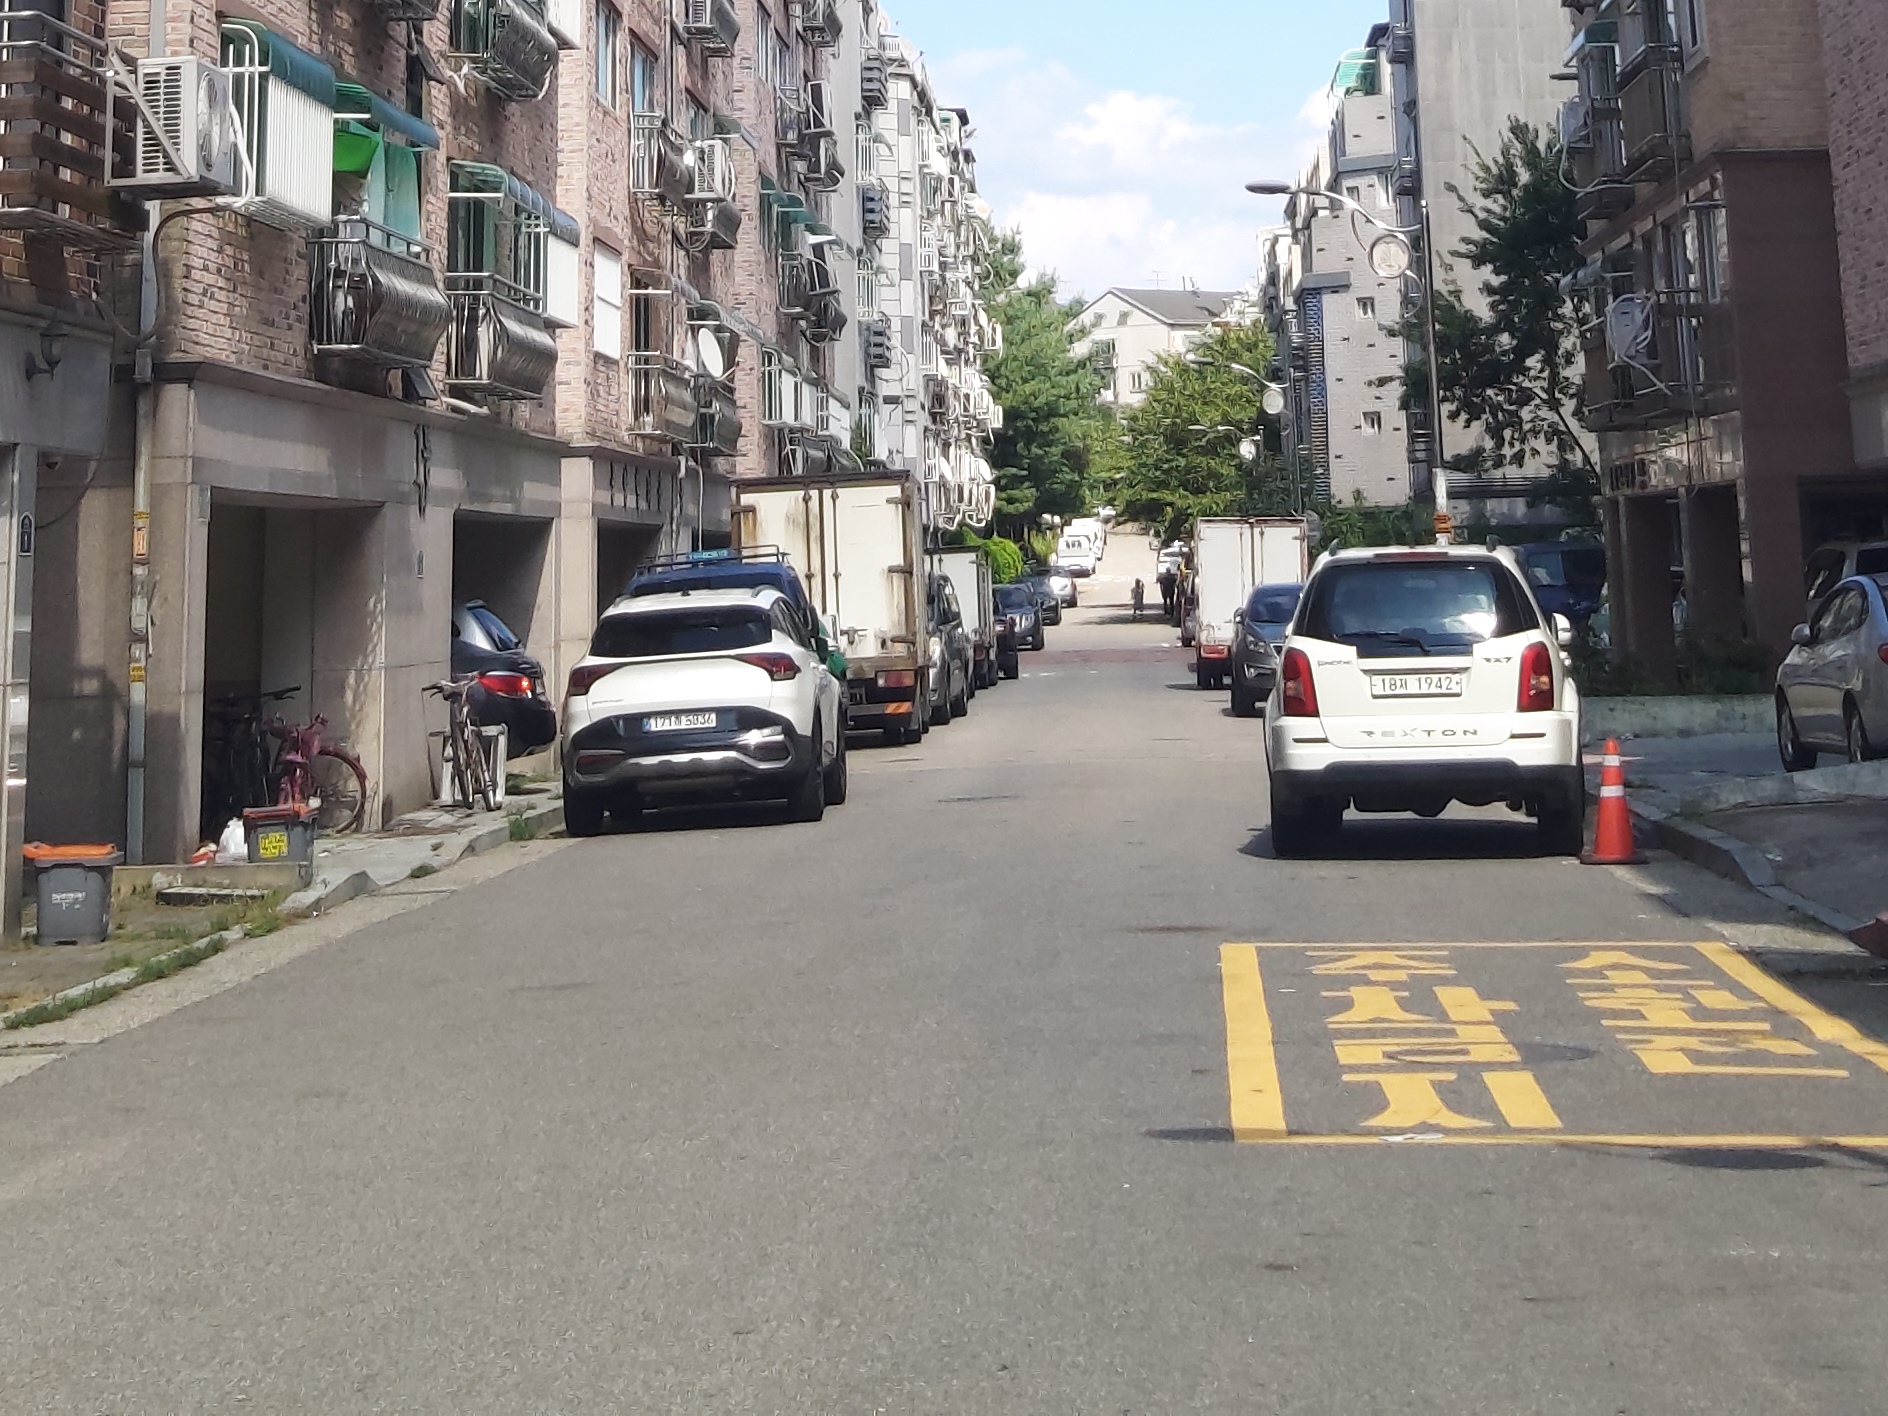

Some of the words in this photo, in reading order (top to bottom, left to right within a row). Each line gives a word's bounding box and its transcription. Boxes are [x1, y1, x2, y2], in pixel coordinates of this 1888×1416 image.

[1416, 676, 1454, 692] 1942
[1360, 727, 1479, 739] REXTON
[1303, 949, 1566, 1130] 주차금지
